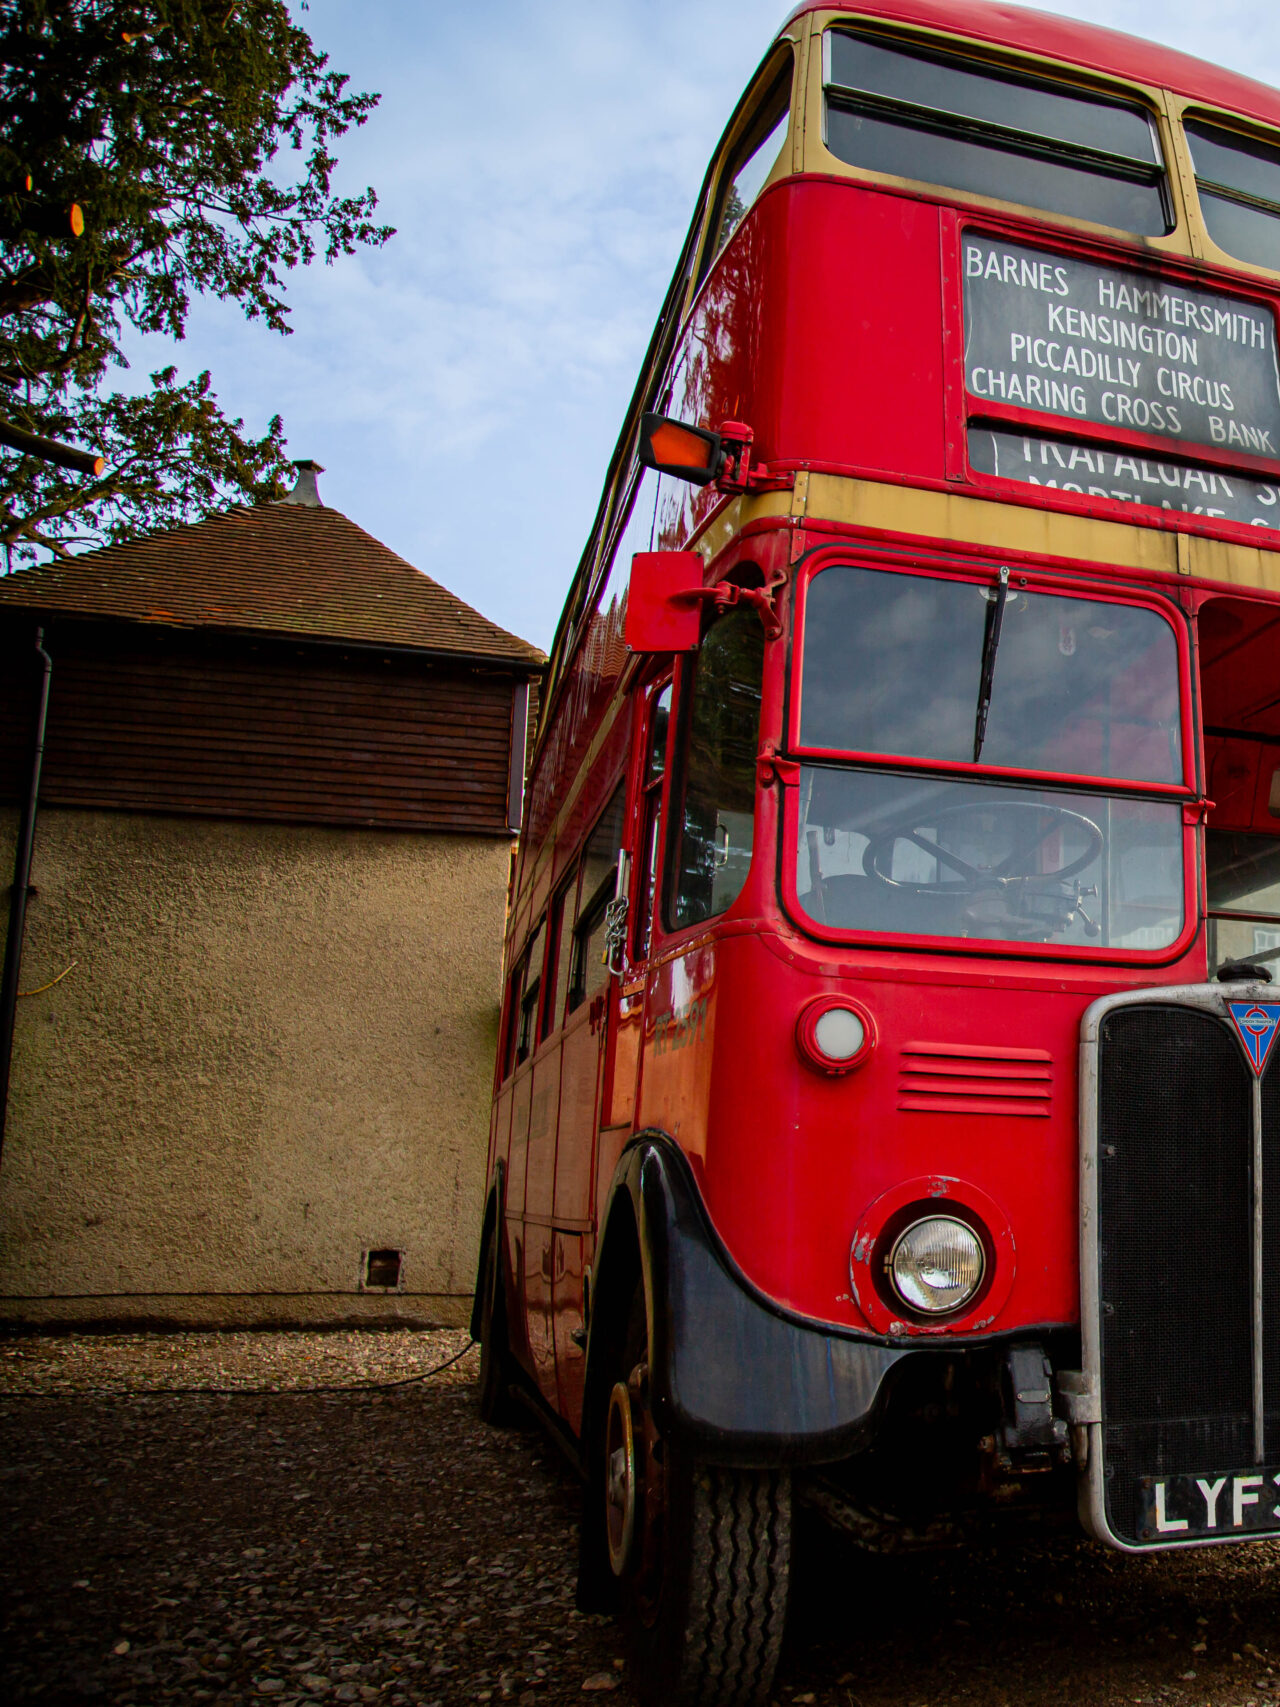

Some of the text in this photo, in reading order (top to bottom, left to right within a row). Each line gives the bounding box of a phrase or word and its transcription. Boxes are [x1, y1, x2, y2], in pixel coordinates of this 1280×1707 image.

[966, 246, 1265, 349] BARNES HAMMERSMITH
[1048, 303, 1198, 366] KENSINGTON
[971, 367, 1277, 454] CHARING CROSS BANK
[1010, 332, 1235, 411] PICCADILLY CIRCUS
